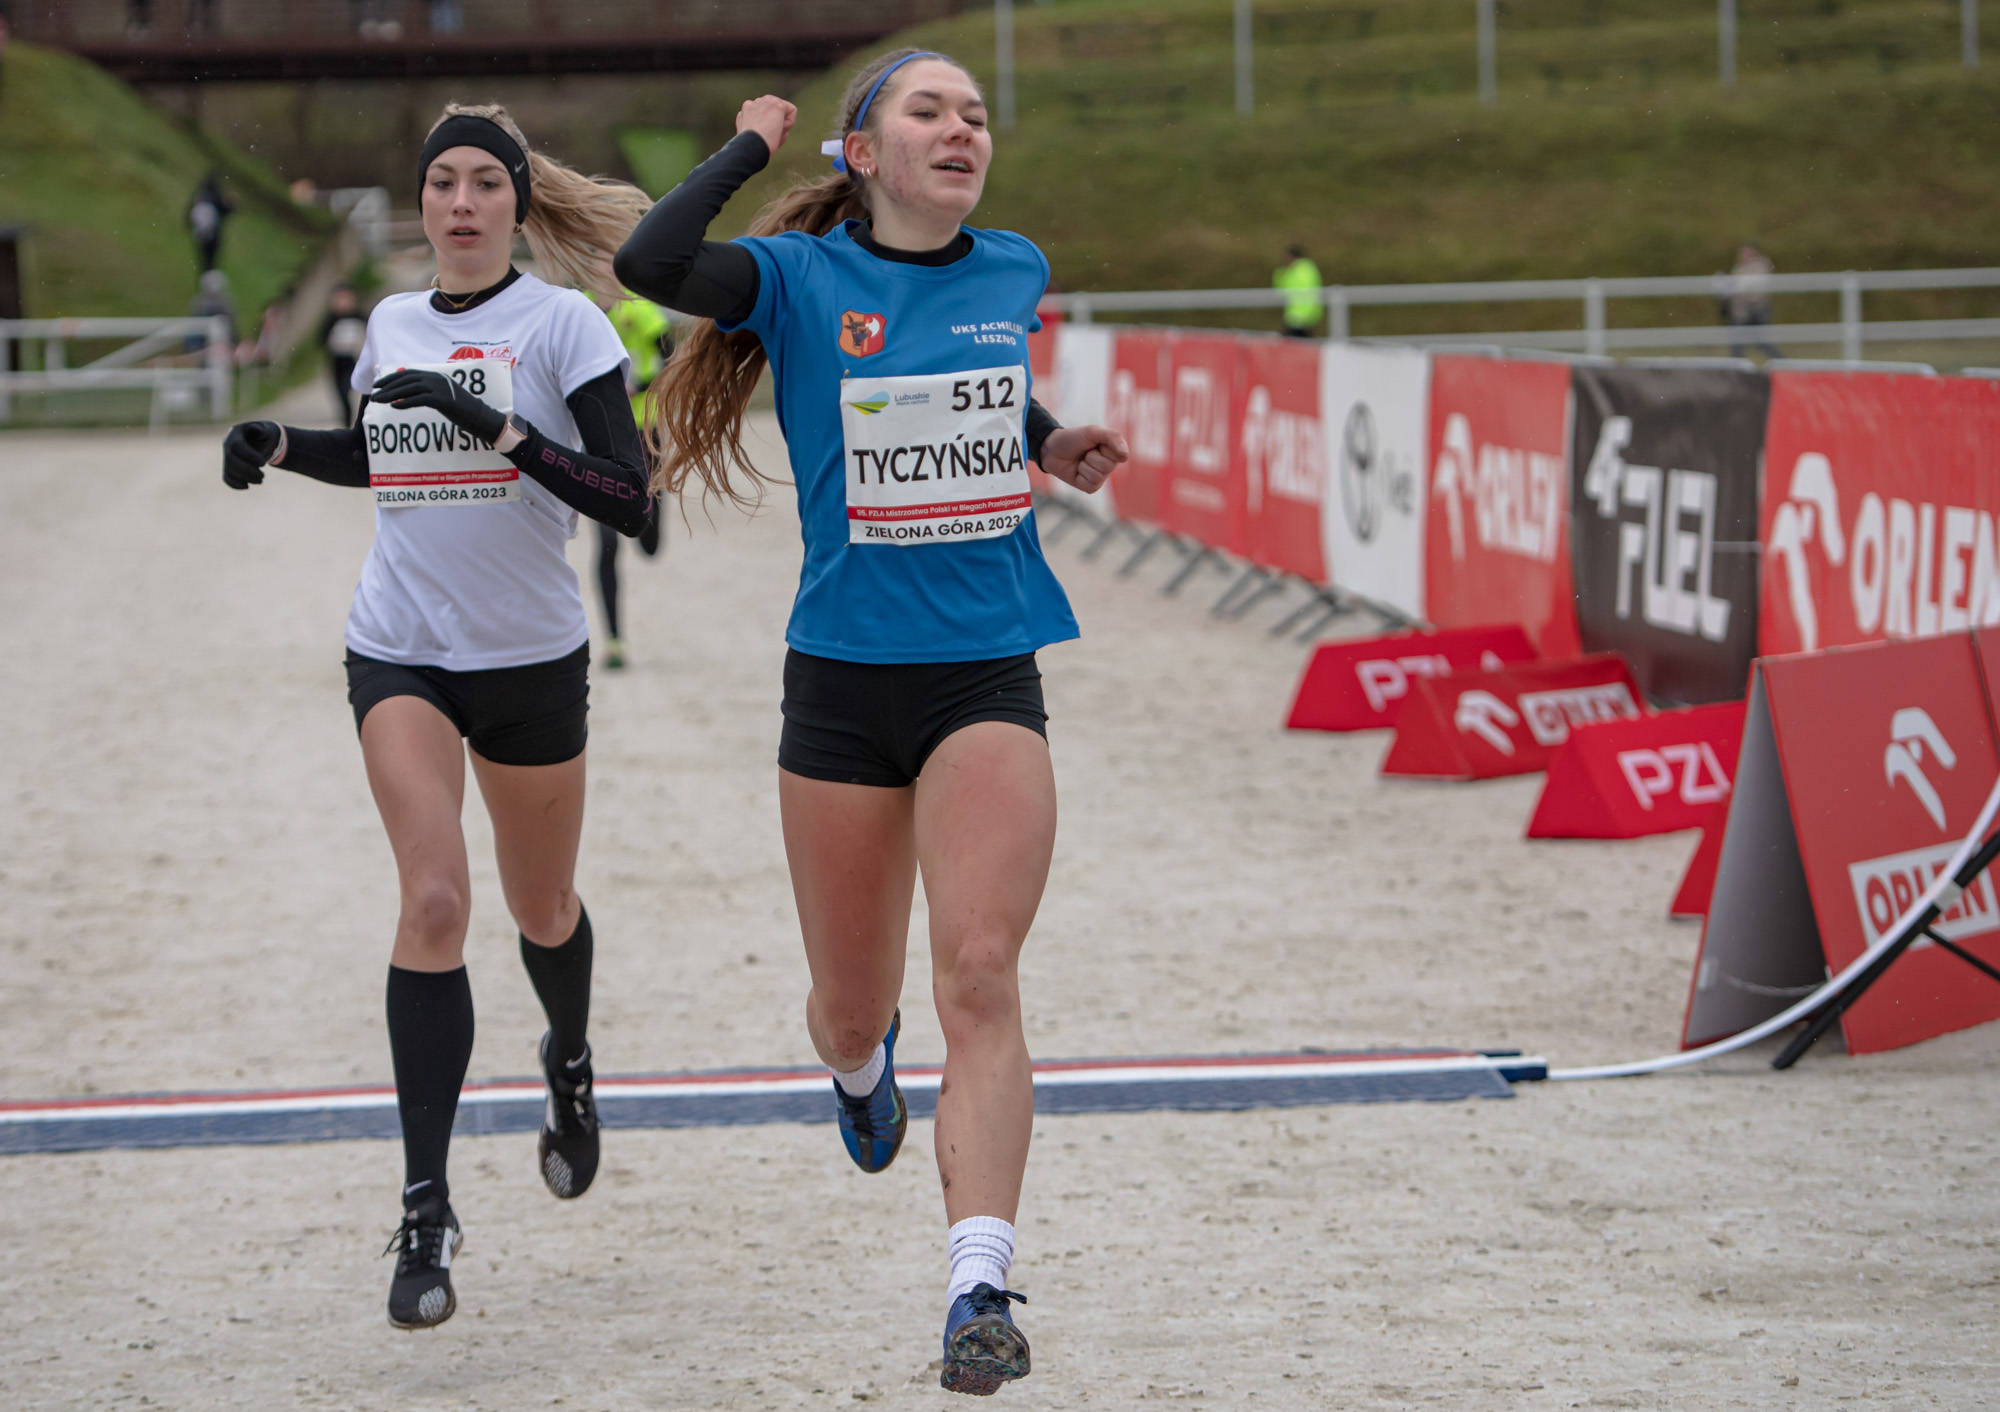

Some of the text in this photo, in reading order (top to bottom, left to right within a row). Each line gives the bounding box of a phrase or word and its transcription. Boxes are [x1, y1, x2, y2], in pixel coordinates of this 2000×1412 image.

[951, 320, 1023, 335] UKS ACHILLES
[974, 334, 1017, 346] LESZNO
[452, 368, 486, 396] 28
[951, 375, 1015, 412] 512
[368, 421, 496, 455] BOROWSK
[852, 433, 1025, 484] TYCZYŃSKA
[376, 487, 507, 502] ZIELONA GÓRA 2023
[886, 508, 929, 517] Mistrzostwa
[930, 504, 951, 514] Polski
[959, 502, 987, 512] Biegach
[865, 514, 1020, 539] ZIELONA GÓRA 2023
[1849, 490, 2000, 636] ORLEN
